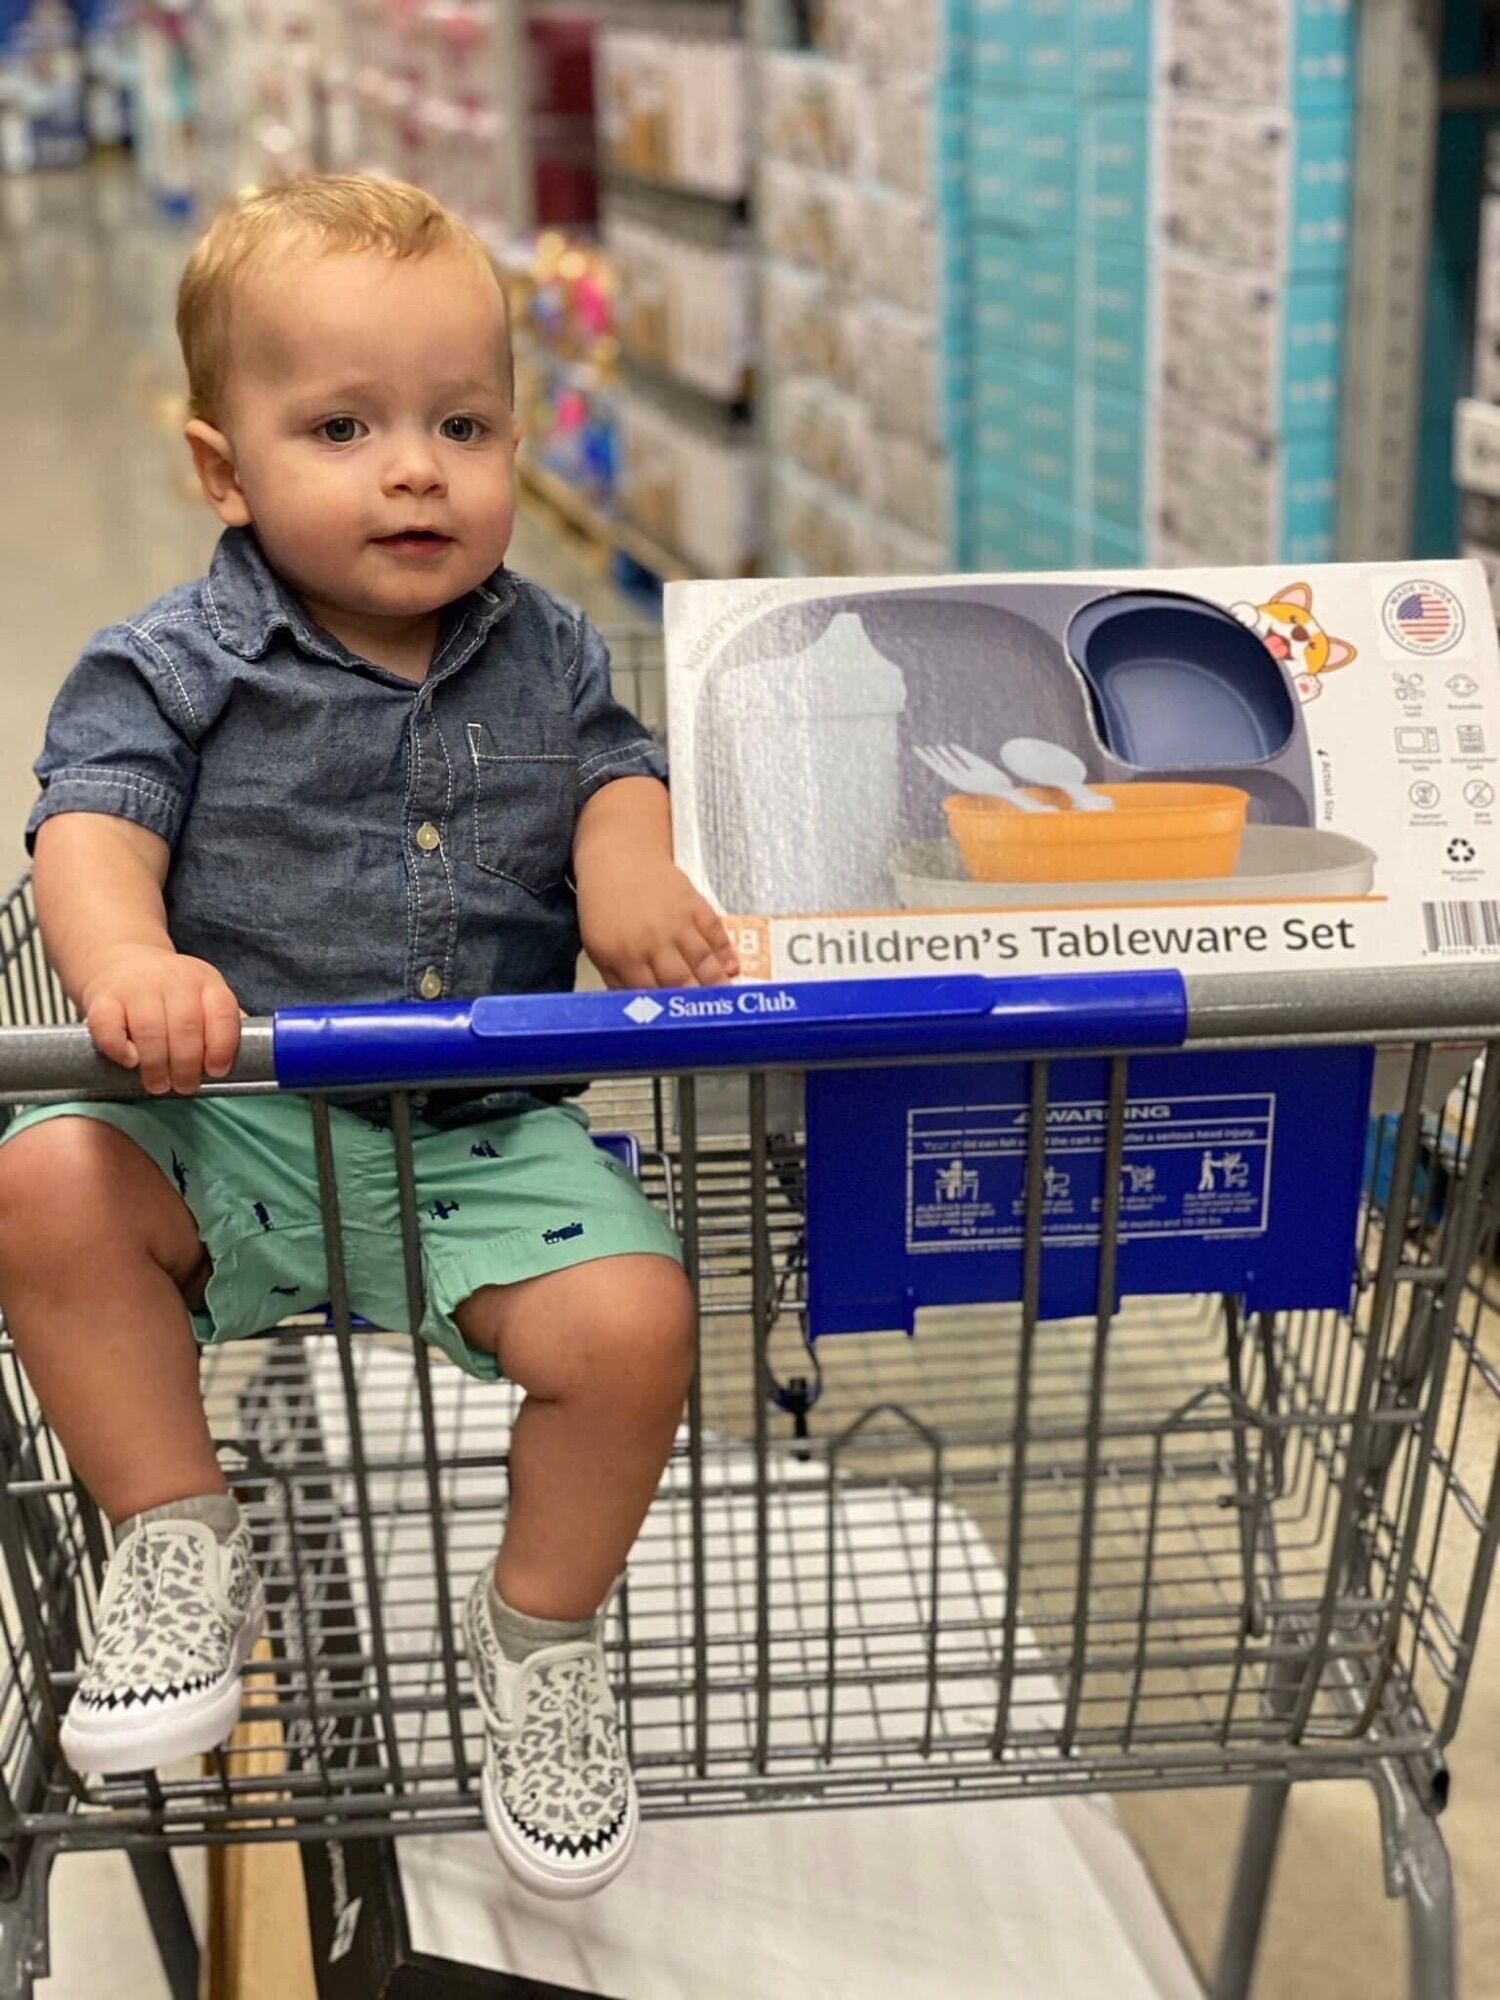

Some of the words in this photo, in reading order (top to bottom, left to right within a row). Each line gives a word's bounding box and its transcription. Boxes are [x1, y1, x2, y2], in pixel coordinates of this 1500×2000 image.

[786, 928, 1019, 965] Children’s
[1031, 923, 1268, 959] Tableware
[1282, 917, 1356, 951] Set
[737, 990, 797, 1014] Club
[1045, 1104, 1171, 1123] WARING
